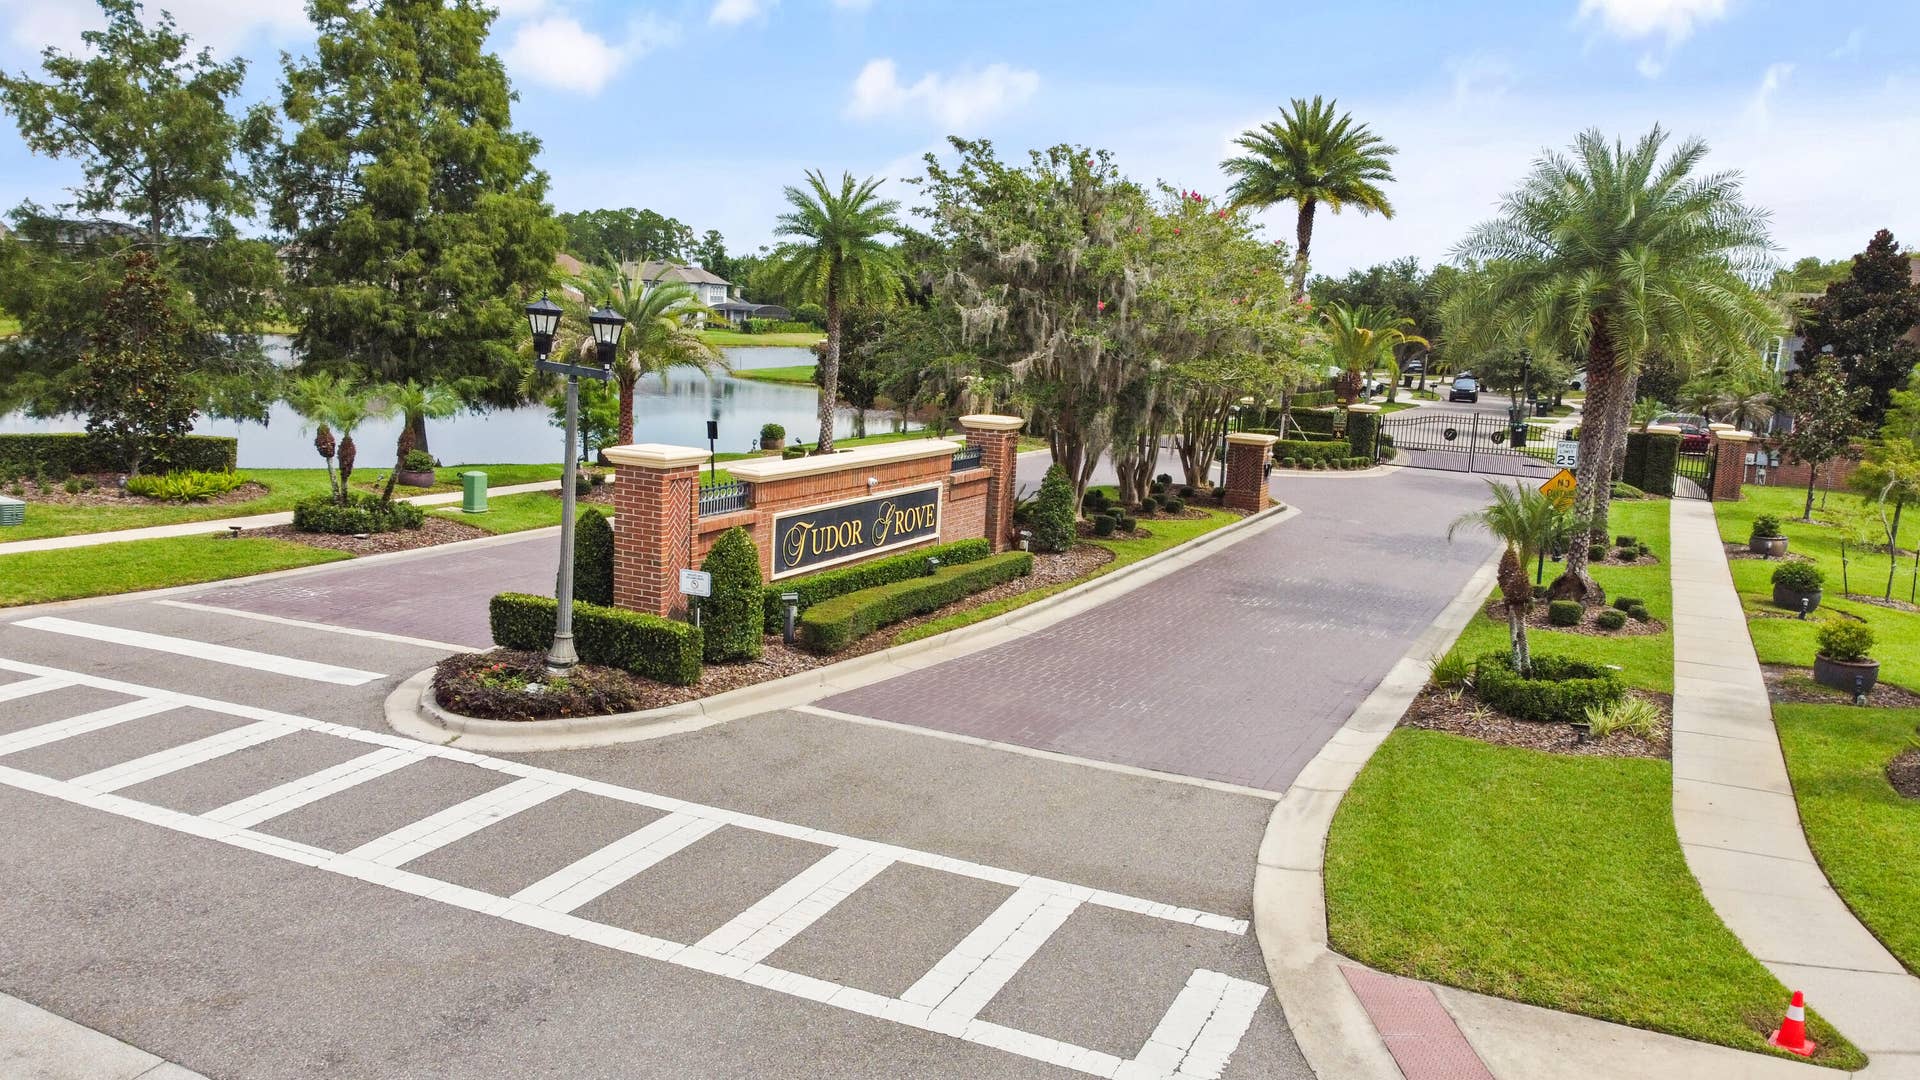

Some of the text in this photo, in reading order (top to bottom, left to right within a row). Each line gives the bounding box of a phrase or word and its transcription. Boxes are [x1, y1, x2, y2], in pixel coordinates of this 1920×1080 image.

[1557, 455, 1575, 466] 25
[783, 501, 935, 567] TUDOR GROVE
